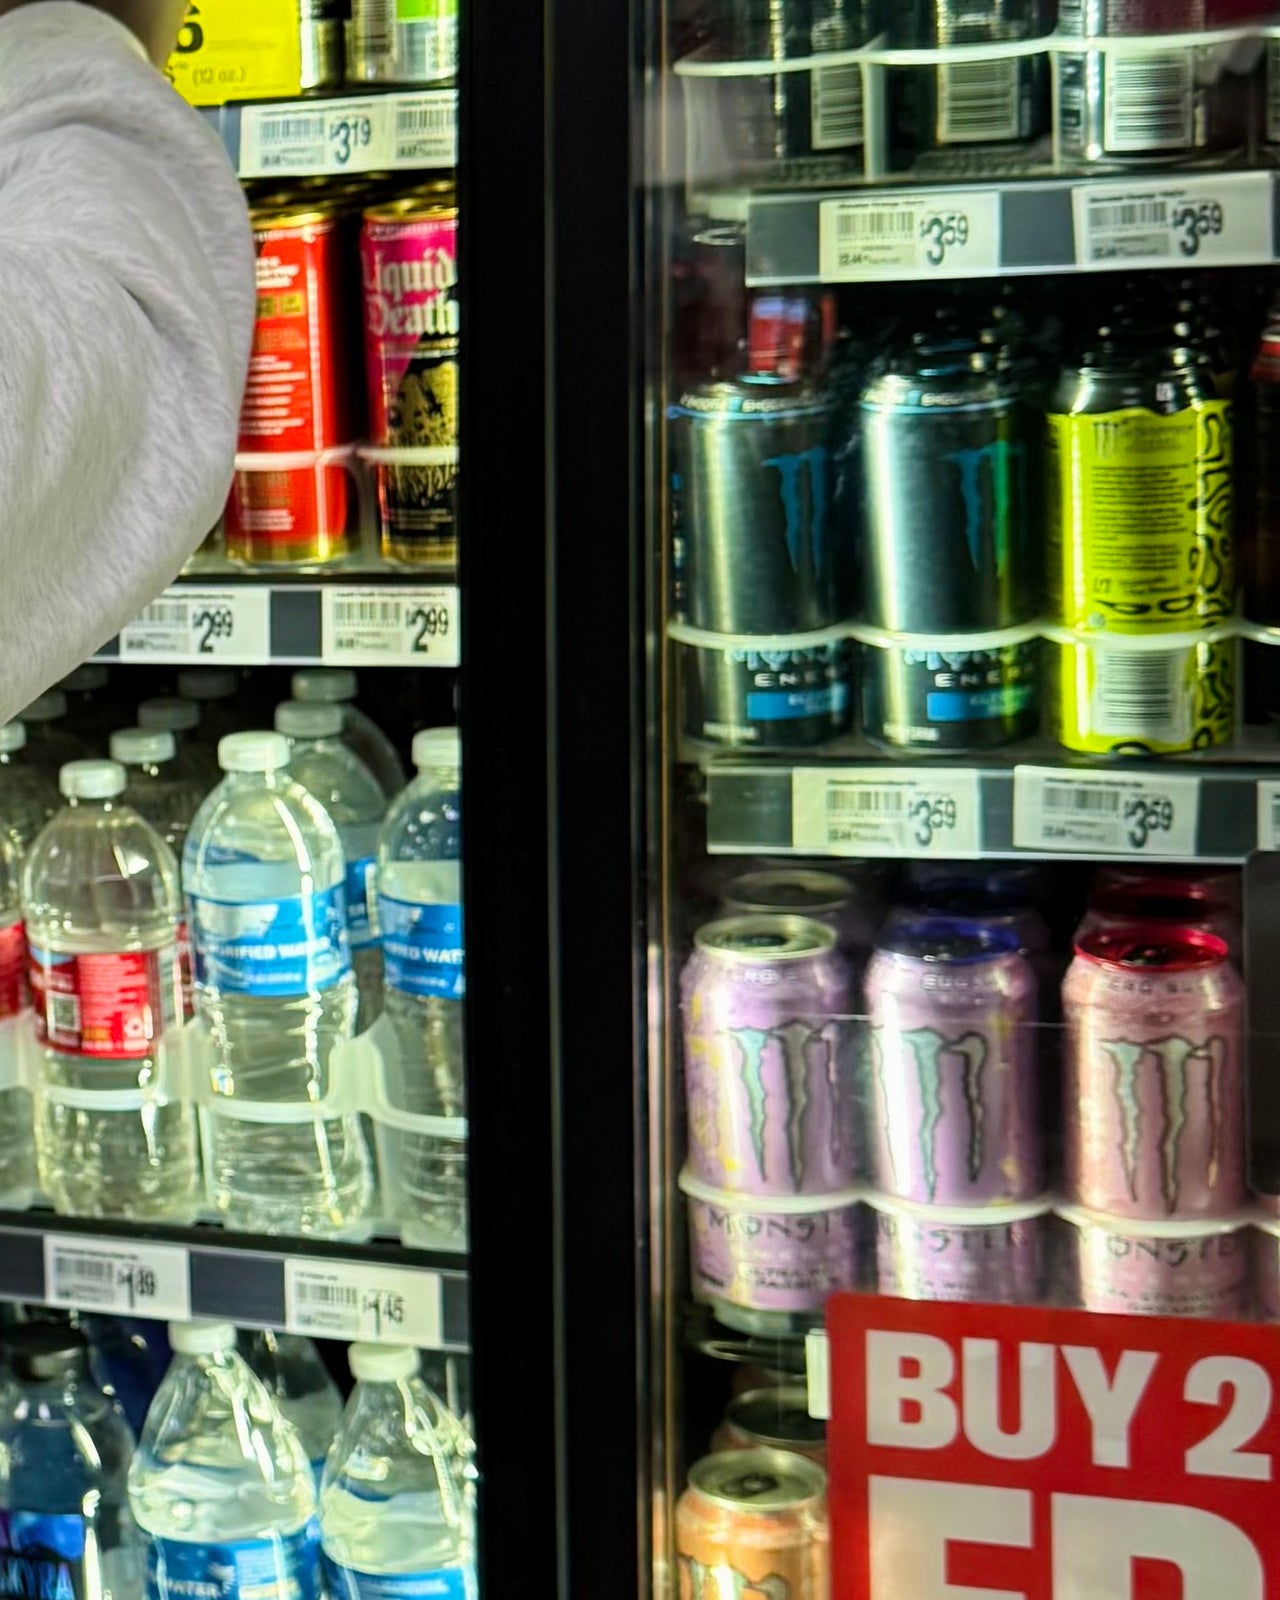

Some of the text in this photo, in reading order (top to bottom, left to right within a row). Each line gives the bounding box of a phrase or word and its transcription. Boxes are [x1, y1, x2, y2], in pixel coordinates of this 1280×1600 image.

[364, 247, 459, 295] Liquid
[367, 293, 460, 337] Death
[864, 1327, 1274, 1482] BUY 2
